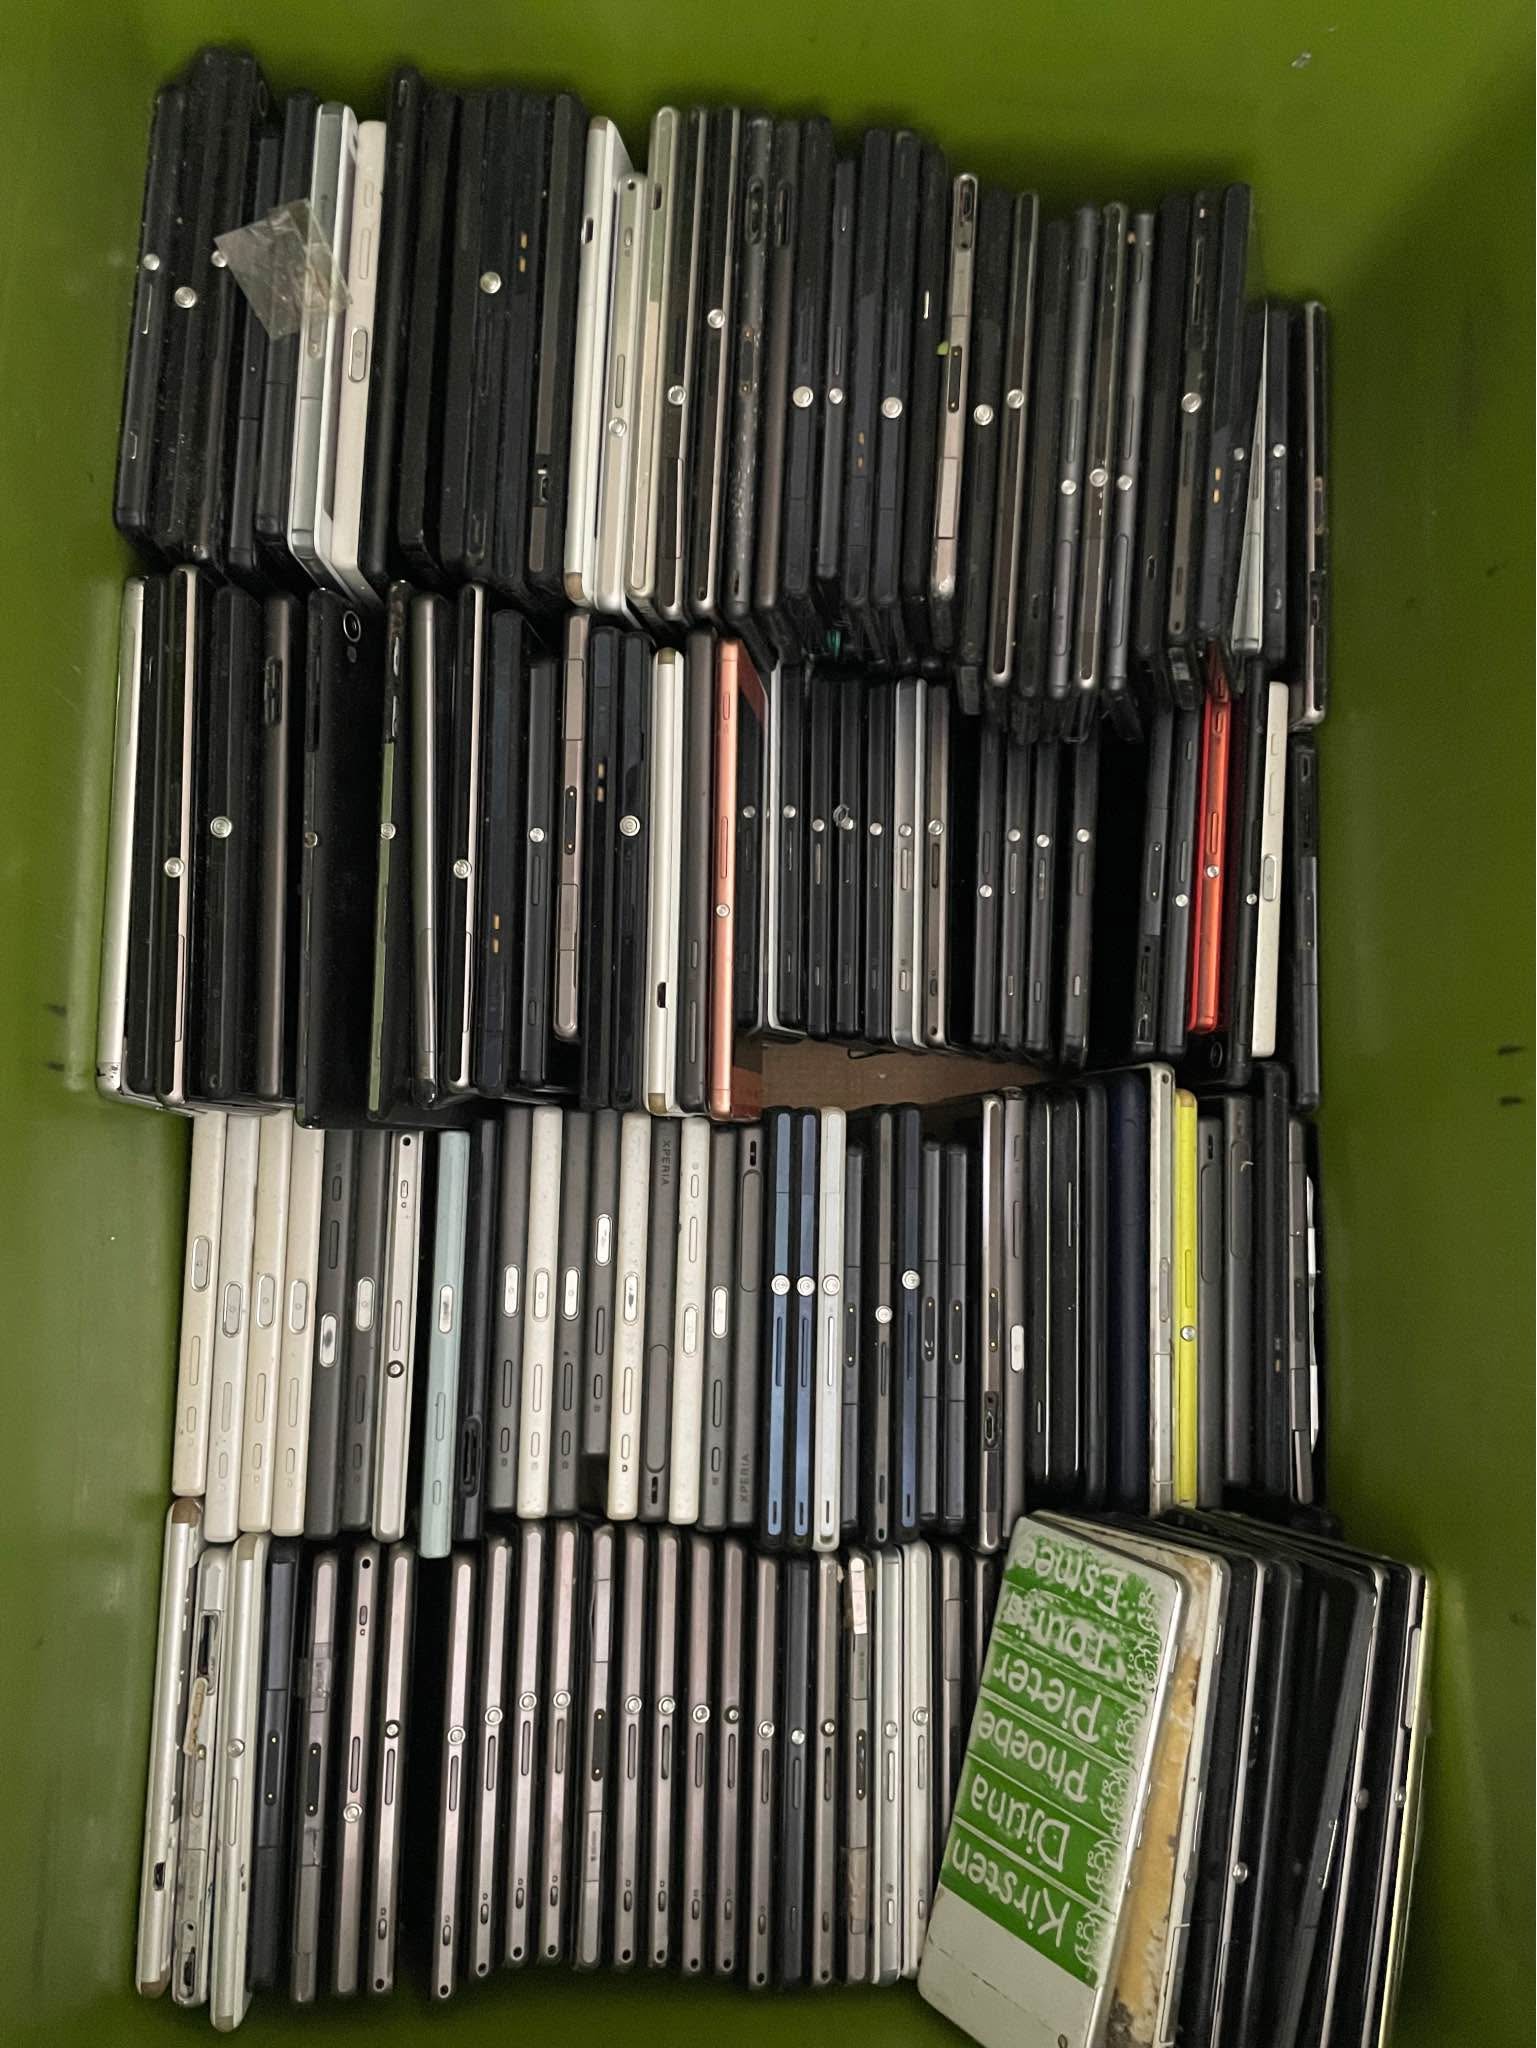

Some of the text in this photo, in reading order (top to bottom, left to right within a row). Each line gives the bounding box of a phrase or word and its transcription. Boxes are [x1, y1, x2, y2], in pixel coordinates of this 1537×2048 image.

[662, 1139, 672, 1187] XPERIA
[993, 1653, 1102, 1744] Pieter
[976, 1709, 1090, 1804] Phoebe
[952, 1838, 1071, 1948] Kirsten
